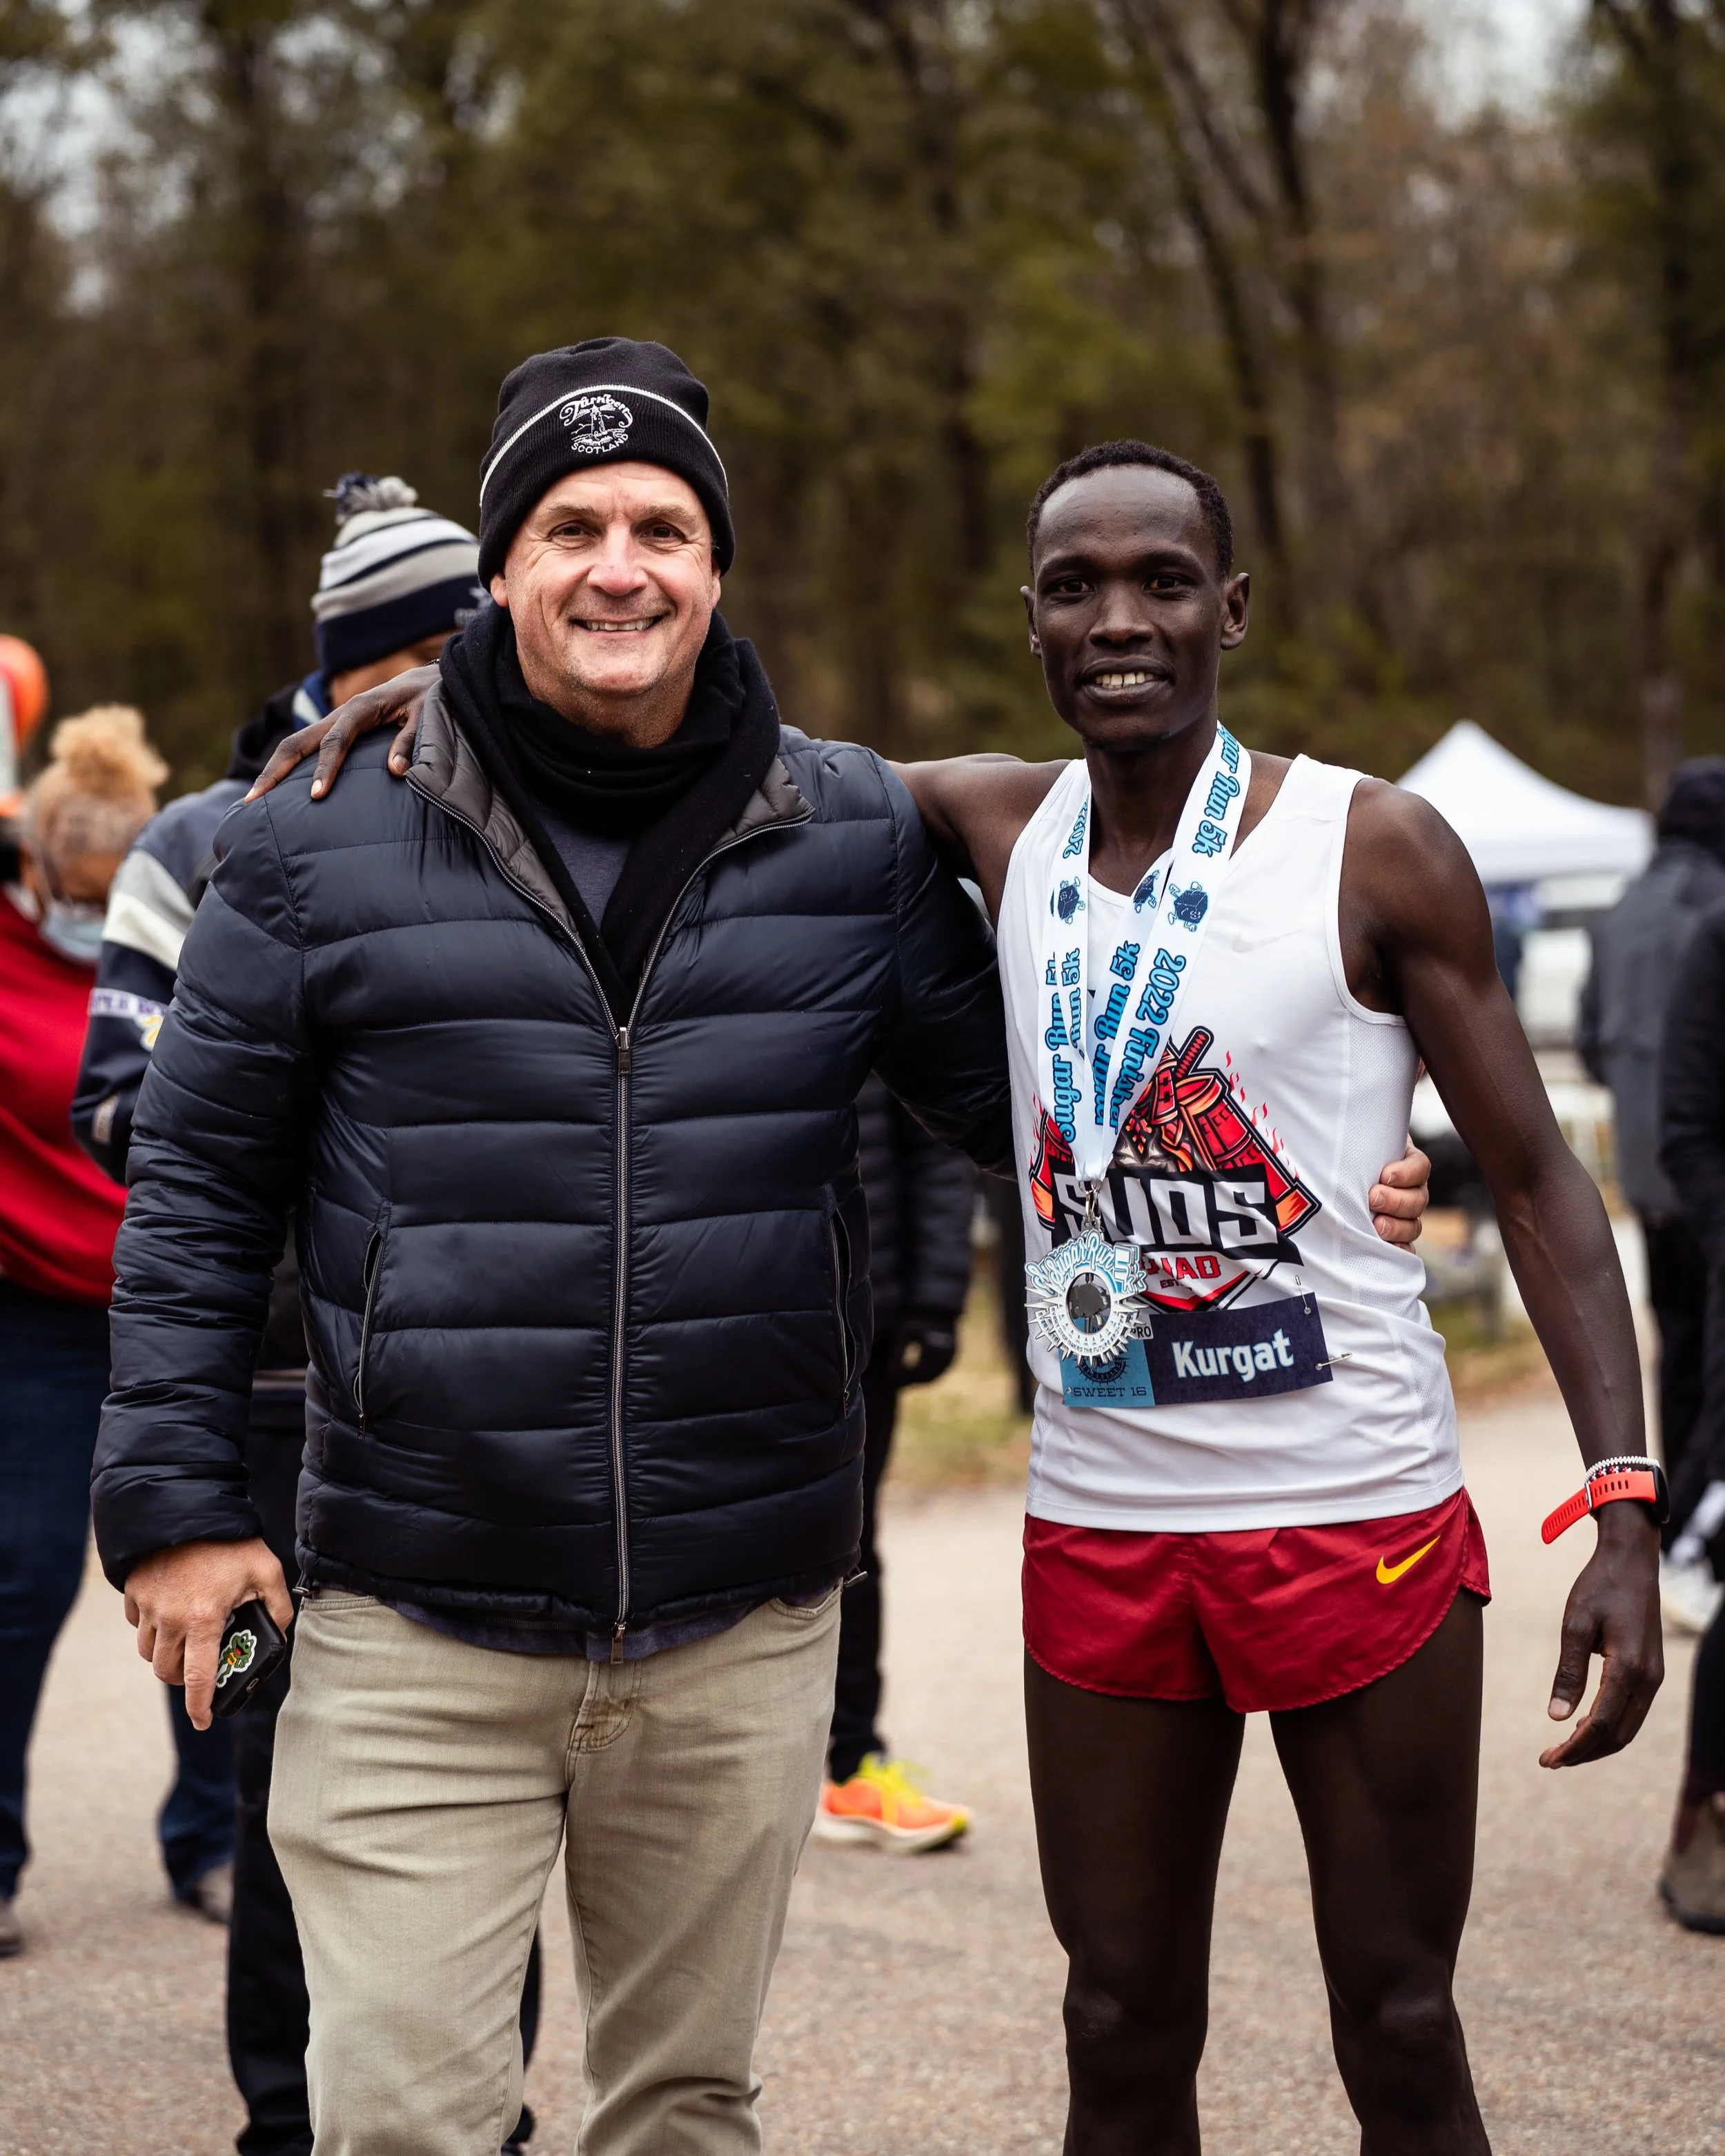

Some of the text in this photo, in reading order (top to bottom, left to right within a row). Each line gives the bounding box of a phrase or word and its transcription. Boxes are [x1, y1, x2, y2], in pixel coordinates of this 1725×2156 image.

[571, 433, 629, 454] SCOTLAND
[1204, 771, 1240, 820] Run
[1192, 820, 1228, 858] 5k
[1110, 940, 1141, 981] 5k
[1061, 947, 1081, 1049] Run 5k
[1110, 948, 1186, 1136] 2022 Finisher
[1052, 1054, 1082, 1143] Sugar
[1044, 1236, 1087, 1291] Sugar
[1086, 1229, 1116, 1271] Run
[1171, 1328, 1294, 1383] Kurgat
[1073, 1386, 1147, 1397] SWEET 16
